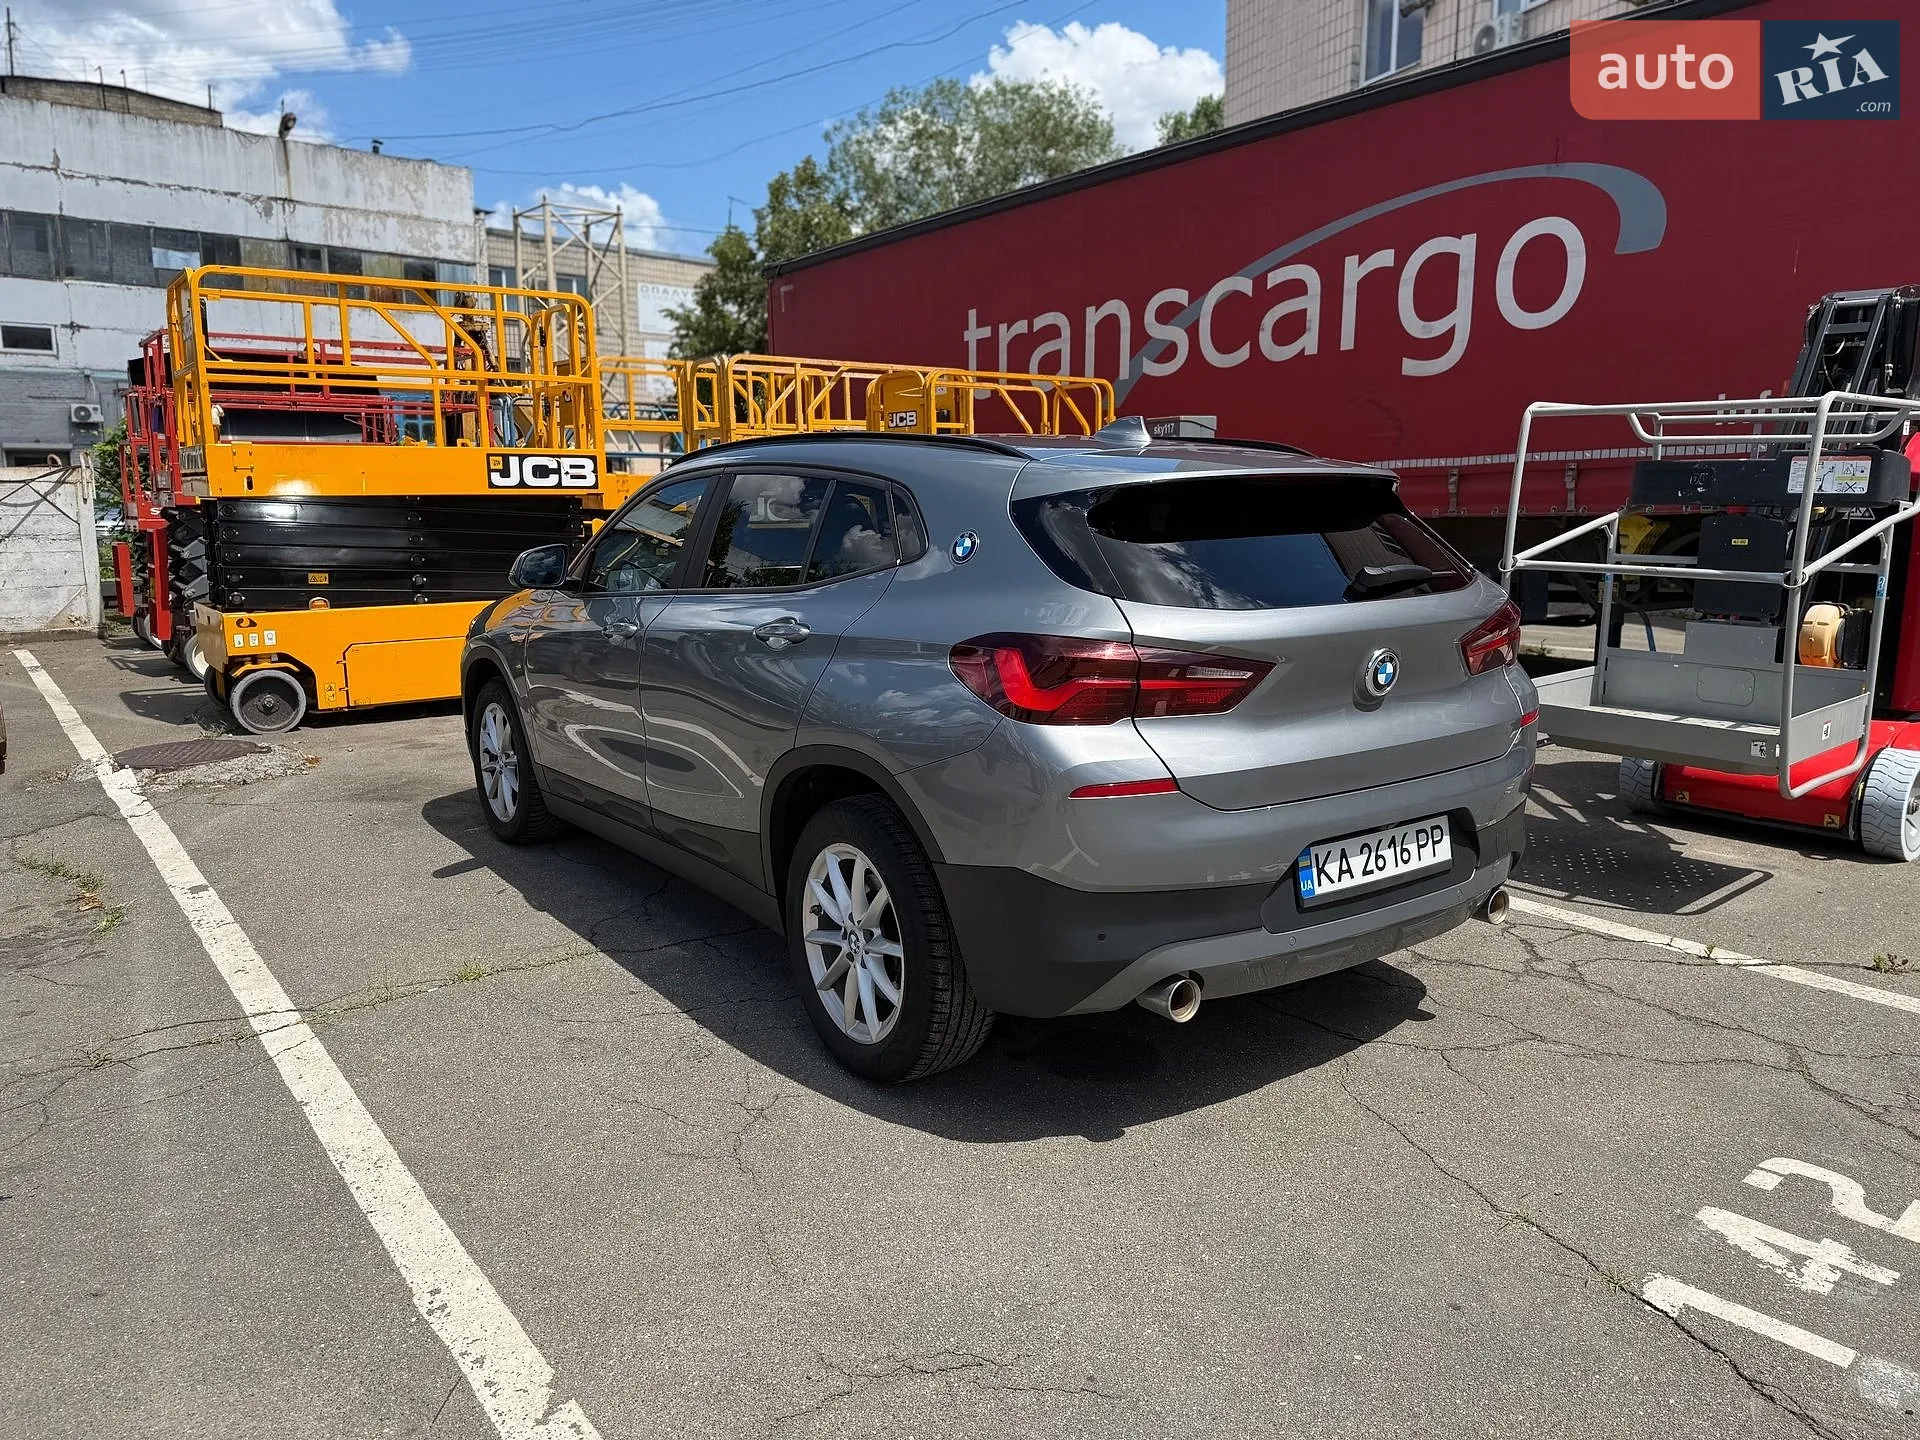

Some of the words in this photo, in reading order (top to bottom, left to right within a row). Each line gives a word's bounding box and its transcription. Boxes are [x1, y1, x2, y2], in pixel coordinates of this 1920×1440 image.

[640, 284, 693, 298] ОПАЛУ
[963, 216, 1587, 399] transcargo
[888, 411, 917, 427] JCB
[1153, 423, 1175, 437] sky117
[490, 456, 596, 486] JCB
[1314, 847, 1354, 887] KA
[1359, 831, 1411, 877] 2616
[1415, 824, 1444, 860] PP
[1300, 880, 1313, 891] UA
[1643, 1156, 1920, 1368] 142
